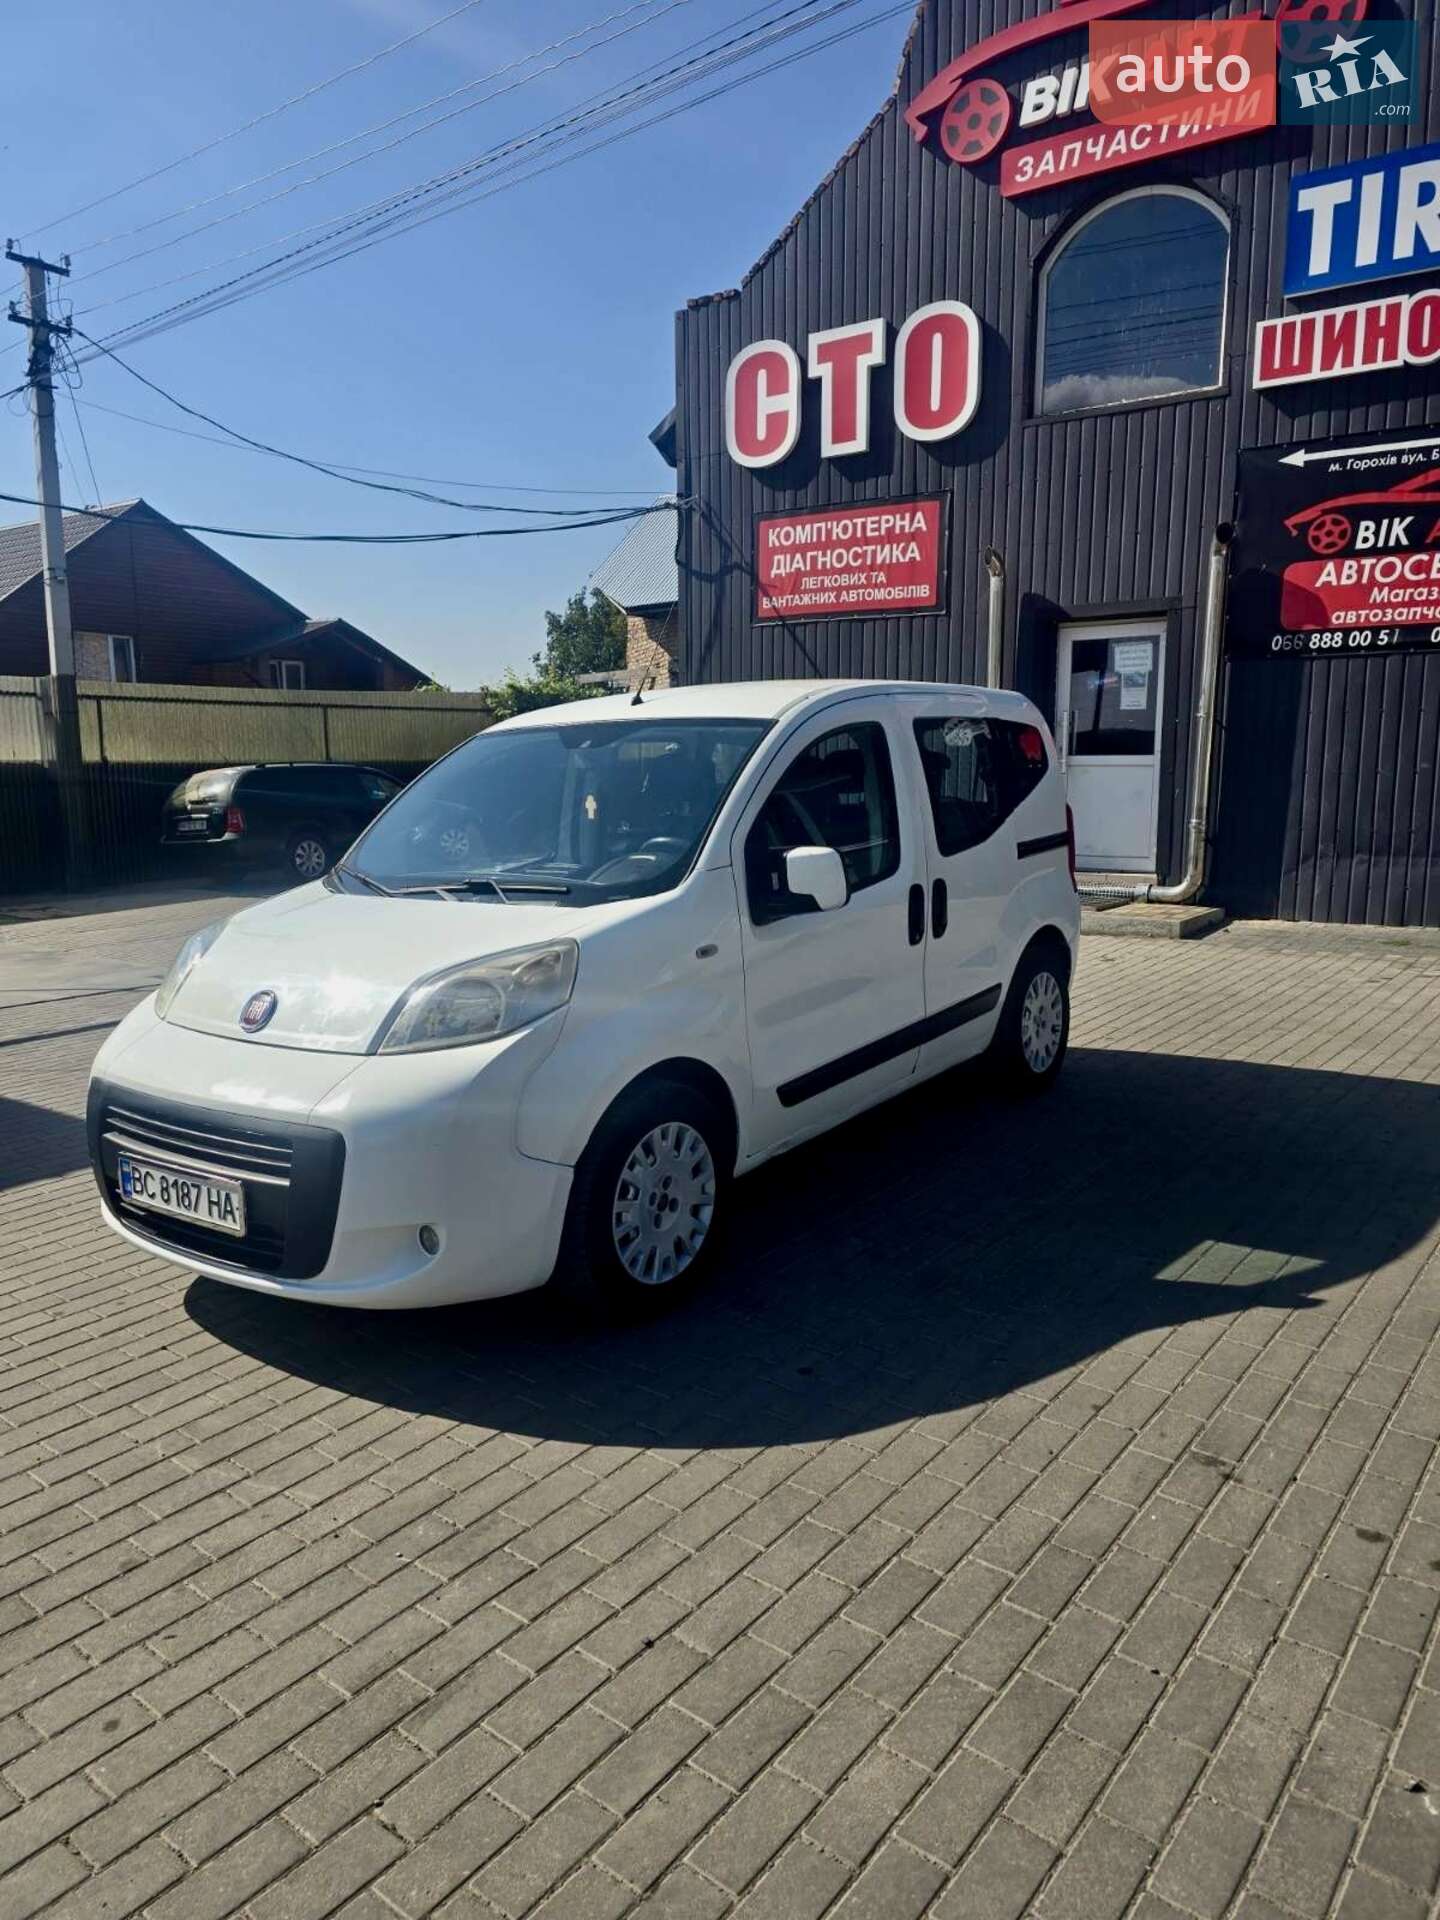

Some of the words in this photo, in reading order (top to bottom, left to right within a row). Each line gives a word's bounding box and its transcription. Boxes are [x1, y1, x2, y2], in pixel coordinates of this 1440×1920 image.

[768, 511, 927, 548] КОМП'ЮТЕРНА
[770, 541, 921, 579] ДІАГНОСТИКА
[801, 573, 867, 590] ЛЕГКОВИХ
[871, 571, 887, 584] ТА
[762, 591, 838, 609] ВАНТАЖНИХ
[839, 584, 930, 604] АВТОМОБІЛІВ
[1369, 586, 1440, 604] Магаз
[1309, 632, 1343, 648] 888
[1349, 631, 1372, 646] 00
[132, 1166, 156, 1199] BC
[160, 1175, 201, 1213] 8187
[207, 1186, 237, 1224] HA
